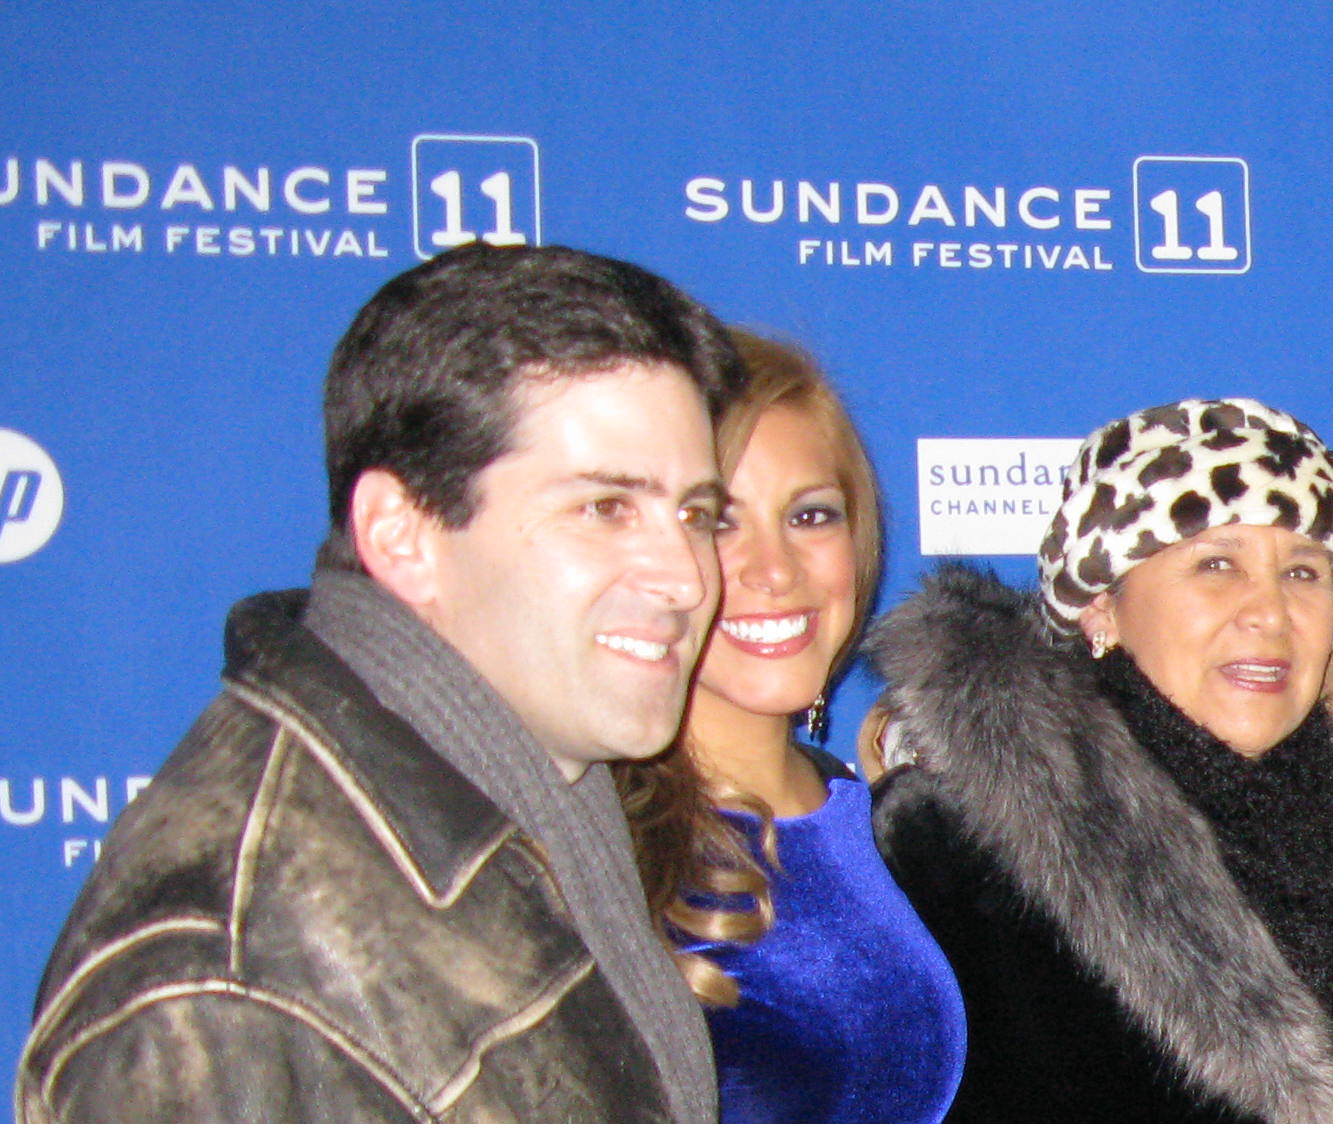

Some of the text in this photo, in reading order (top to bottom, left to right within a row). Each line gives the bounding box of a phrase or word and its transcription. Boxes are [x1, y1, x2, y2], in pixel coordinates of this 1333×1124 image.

[431, 169, 526, 247] 11
[685, 177, 1112, 230] SUNDANCE
[1150, 189, 1239, 261] 11
[37, 222, 389, 258] FILM FESTIVAL
[798, 239, 1113, 271] FILM FESTIVAL
[930, 499, 1050, 516] CHANNEL
